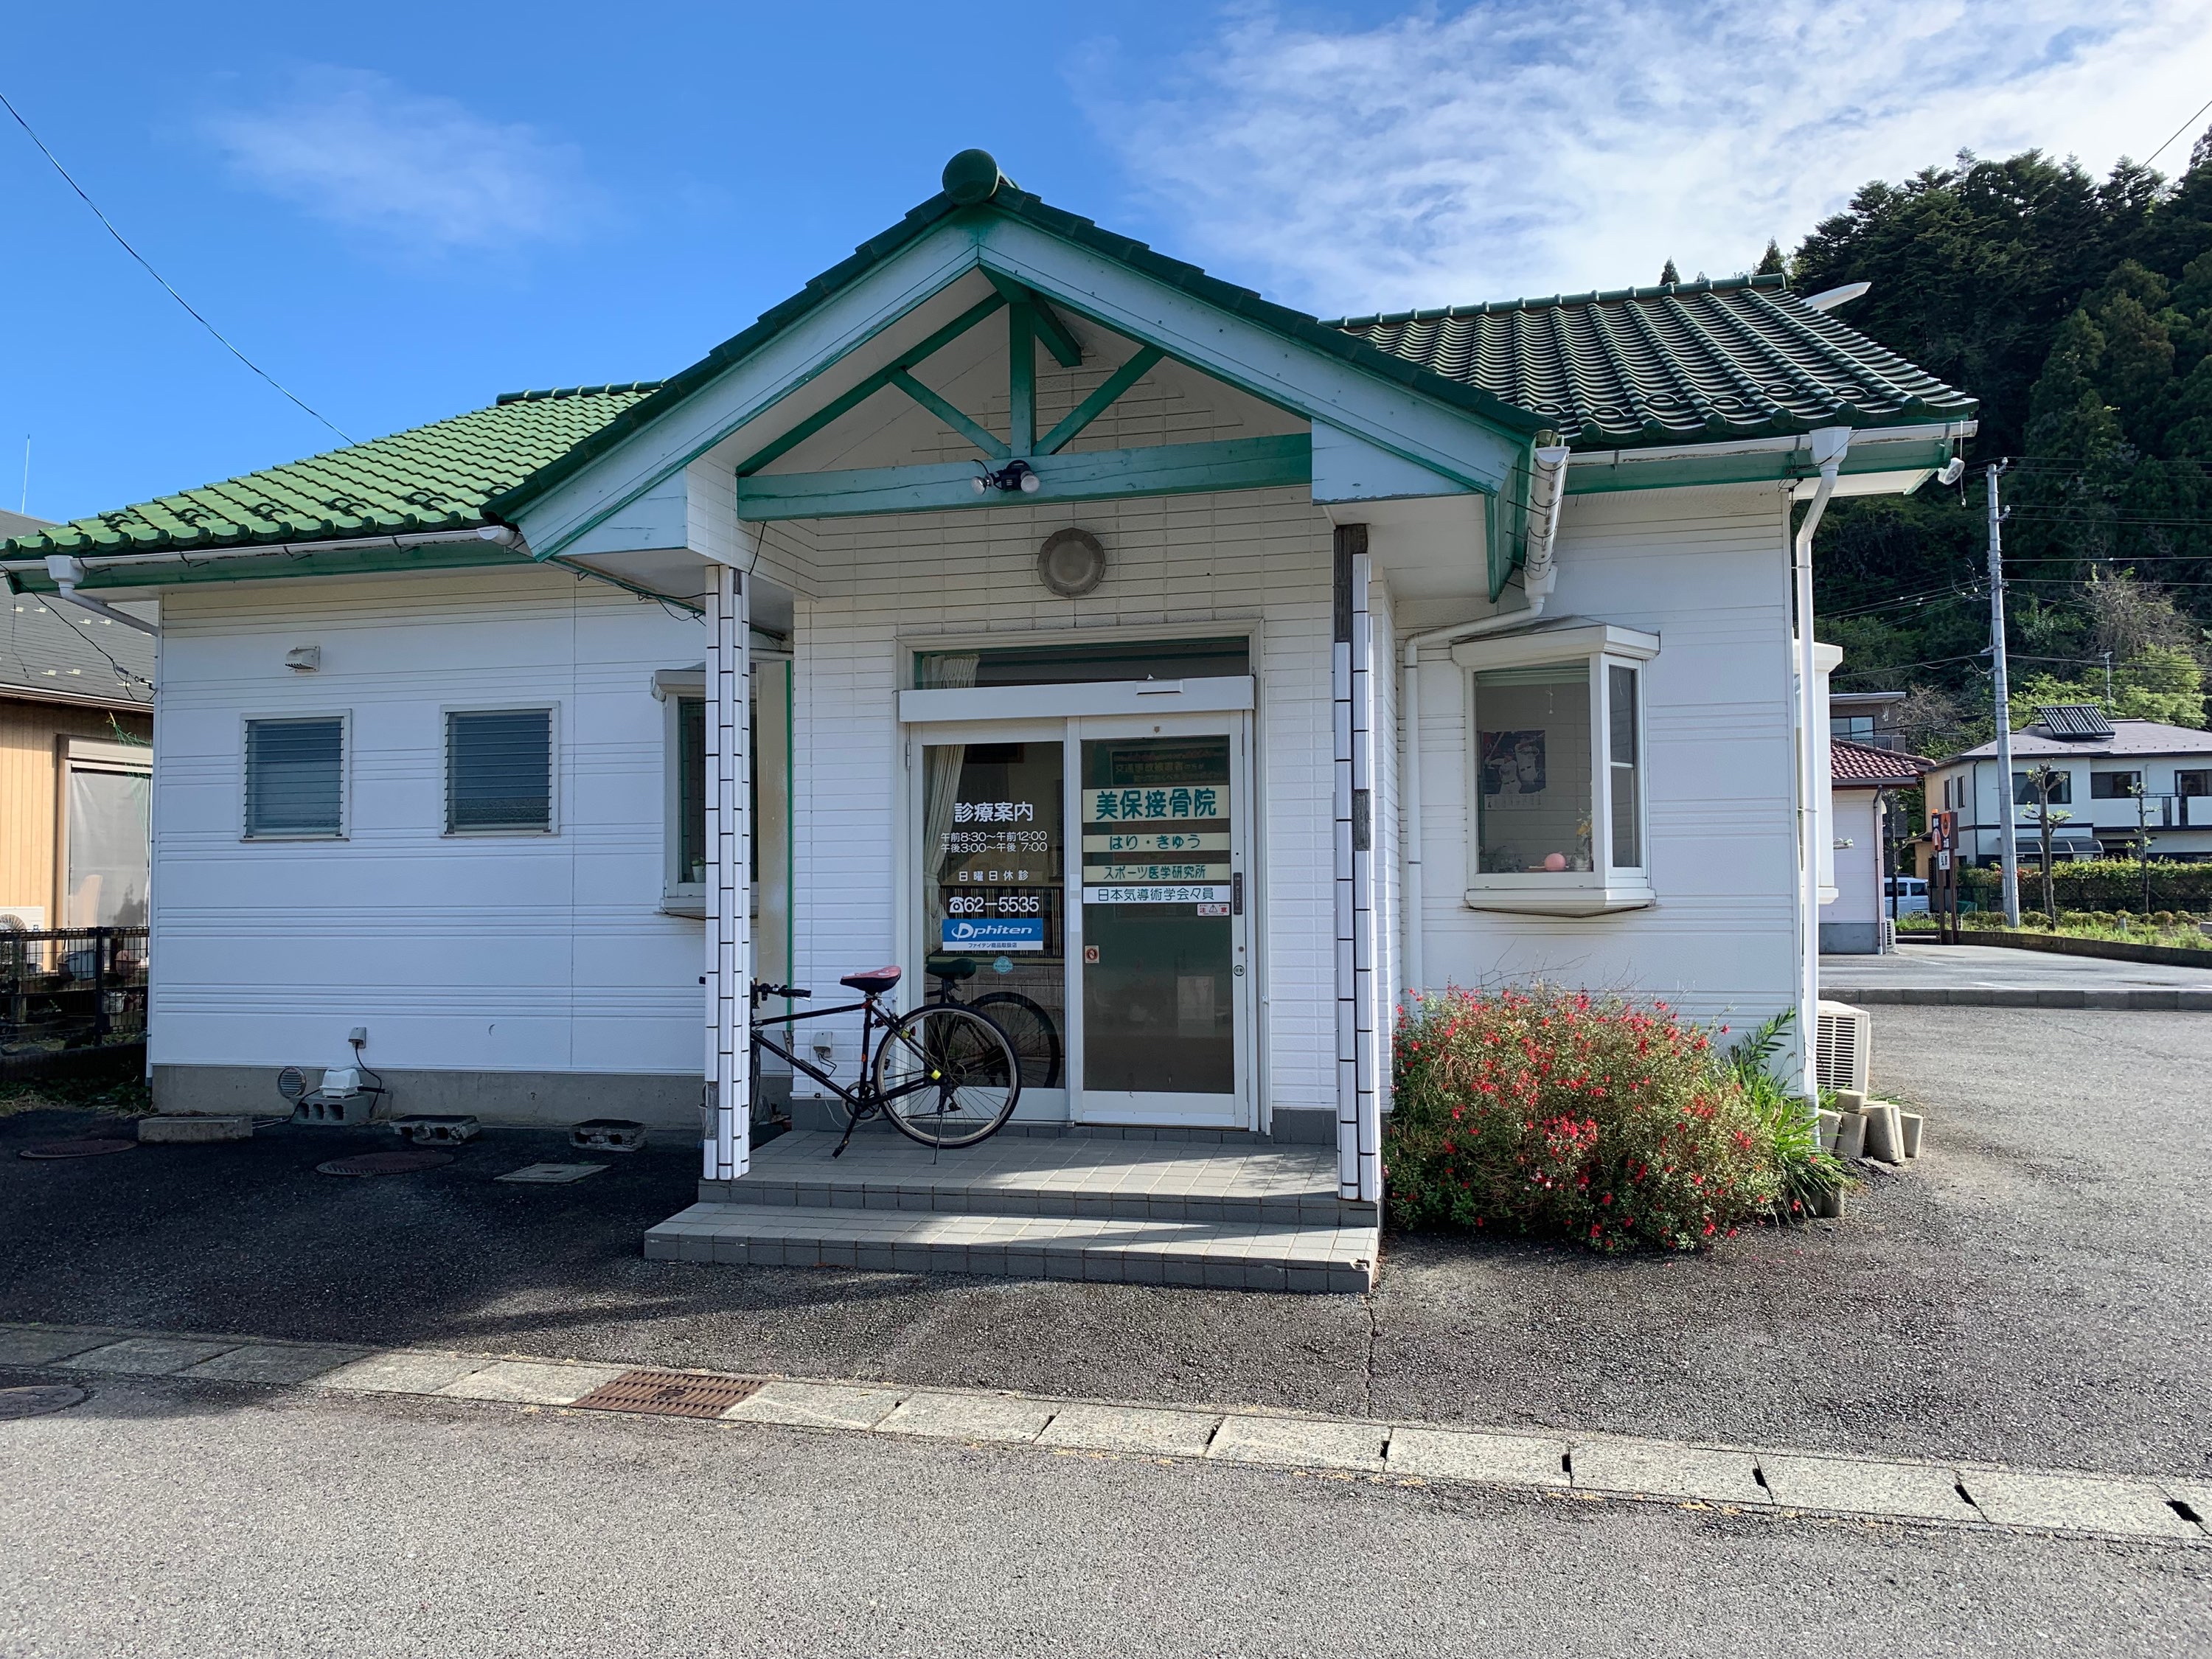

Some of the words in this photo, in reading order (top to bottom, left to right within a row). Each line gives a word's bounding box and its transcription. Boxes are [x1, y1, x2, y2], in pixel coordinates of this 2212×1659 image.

[1096, 787, 1217, 820] 美保接骨院
[954, 801, 1033, 823] 診療案内
[1020, 841, 1048, 852] 7:00
[1110, 834, 1200, 850] はり・きゅう
[959, 870, 1029, 882] 日曜日休診
[1104, 864, 1206, 880] スポーツ医学研究所
[1098, 887, 1214, 902] 日本気導術学会々員
[973, 925, 1032, 939] phiten
